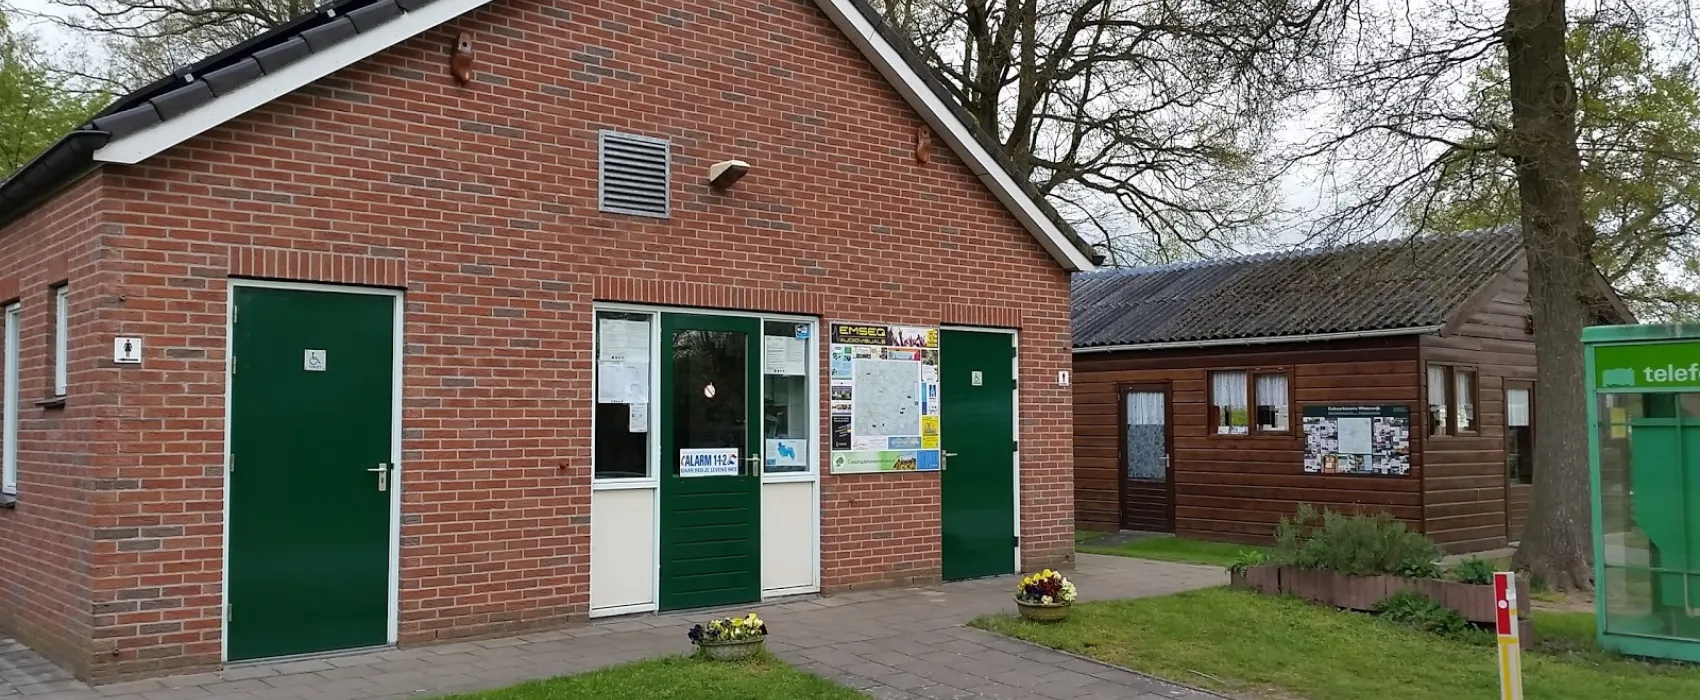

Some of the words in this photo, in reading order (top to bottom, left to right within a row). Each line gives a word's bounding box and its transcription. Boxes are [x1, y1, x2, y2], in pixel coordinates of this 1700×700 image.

[839, 326, 886, 337] EMSEQ
[1643, 362, 1700, 382] telef
[685, 454, 712, 466] ALARM
